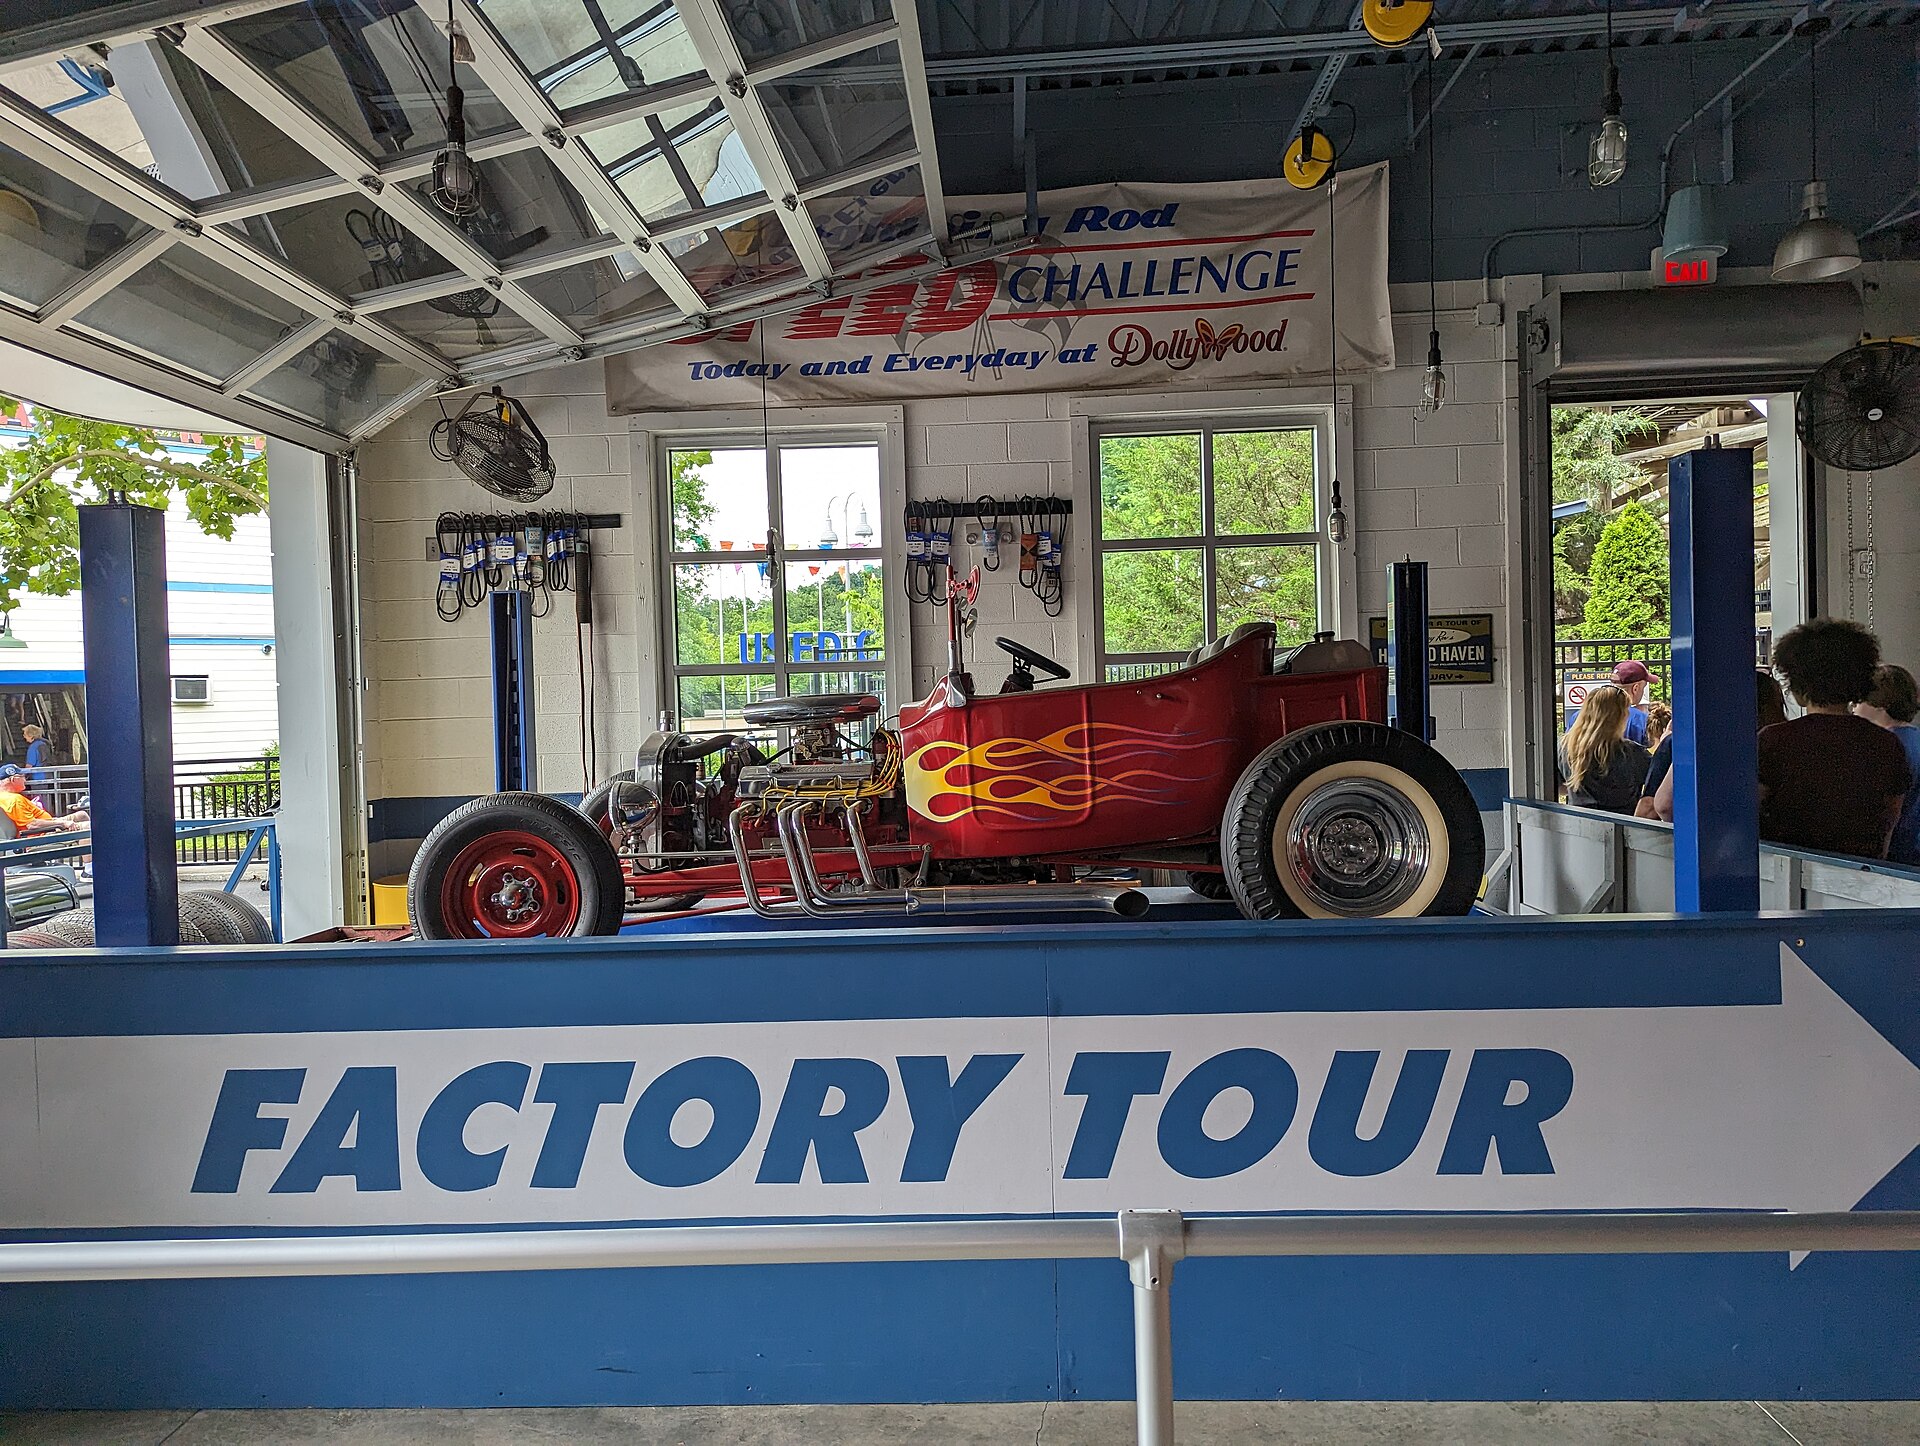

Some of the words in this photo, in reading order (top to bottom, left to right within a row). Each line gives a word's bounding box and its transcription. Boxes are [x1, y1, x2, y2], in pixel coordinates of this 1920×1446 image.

[1064, 203, 1180, 233] Rod
[1008, 249, 1302, 304] CHALLENGE
[688, 359, 791, 381] Today
[799, 355, 874, 377] and
[882, 348, 1049, 375] Everyday
[1058, 343, 1098, 364] at
[1440, 645, 1485, 662] HAVEN
[191, 1053, 1025, 1195] FACTORY
[1062, 1047, 1574, 1180] TOUR
